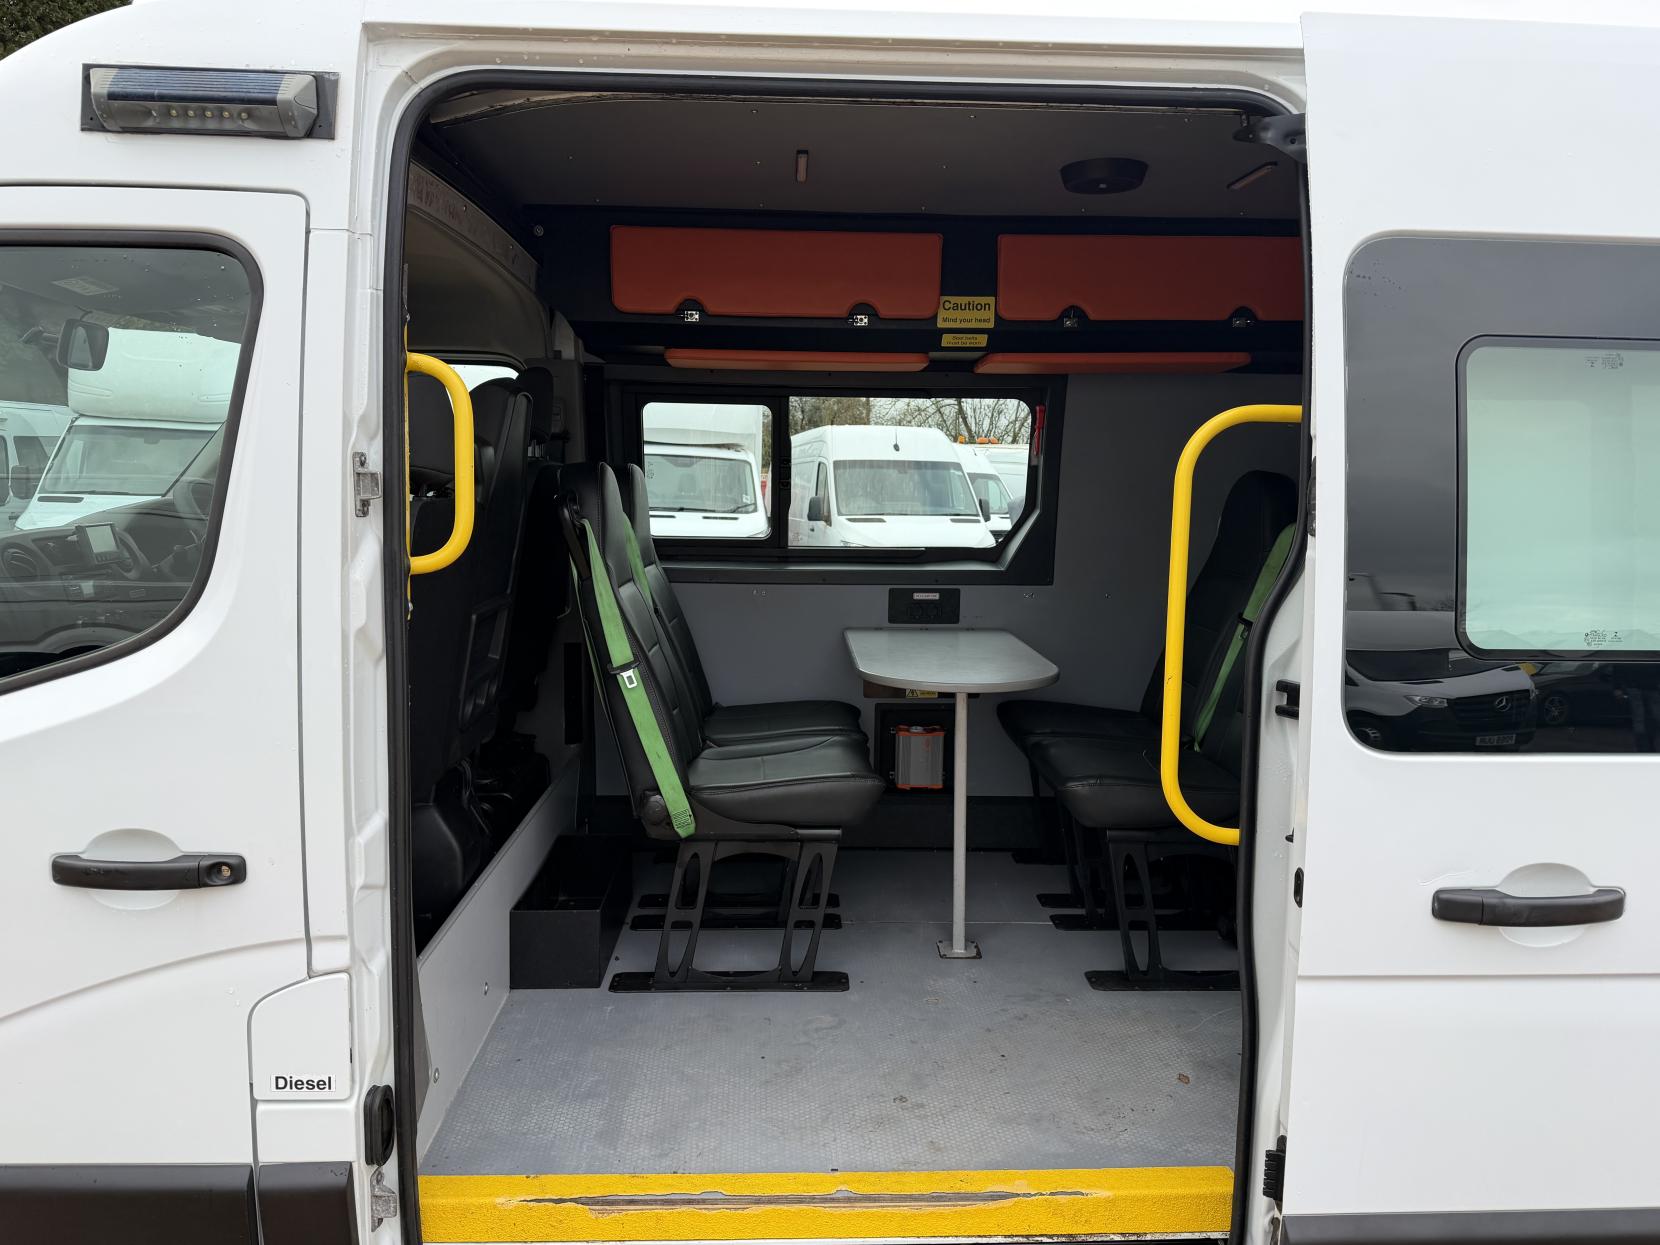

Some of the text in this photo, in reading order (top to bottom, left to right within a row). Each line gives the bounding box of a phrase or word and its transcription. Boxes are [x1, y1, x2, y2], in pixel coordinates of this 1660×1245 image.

[942, 300, 991, 311] Caution
[959, 317, 973, 325] your
[275, 1076, 332, 1091] Diesel
